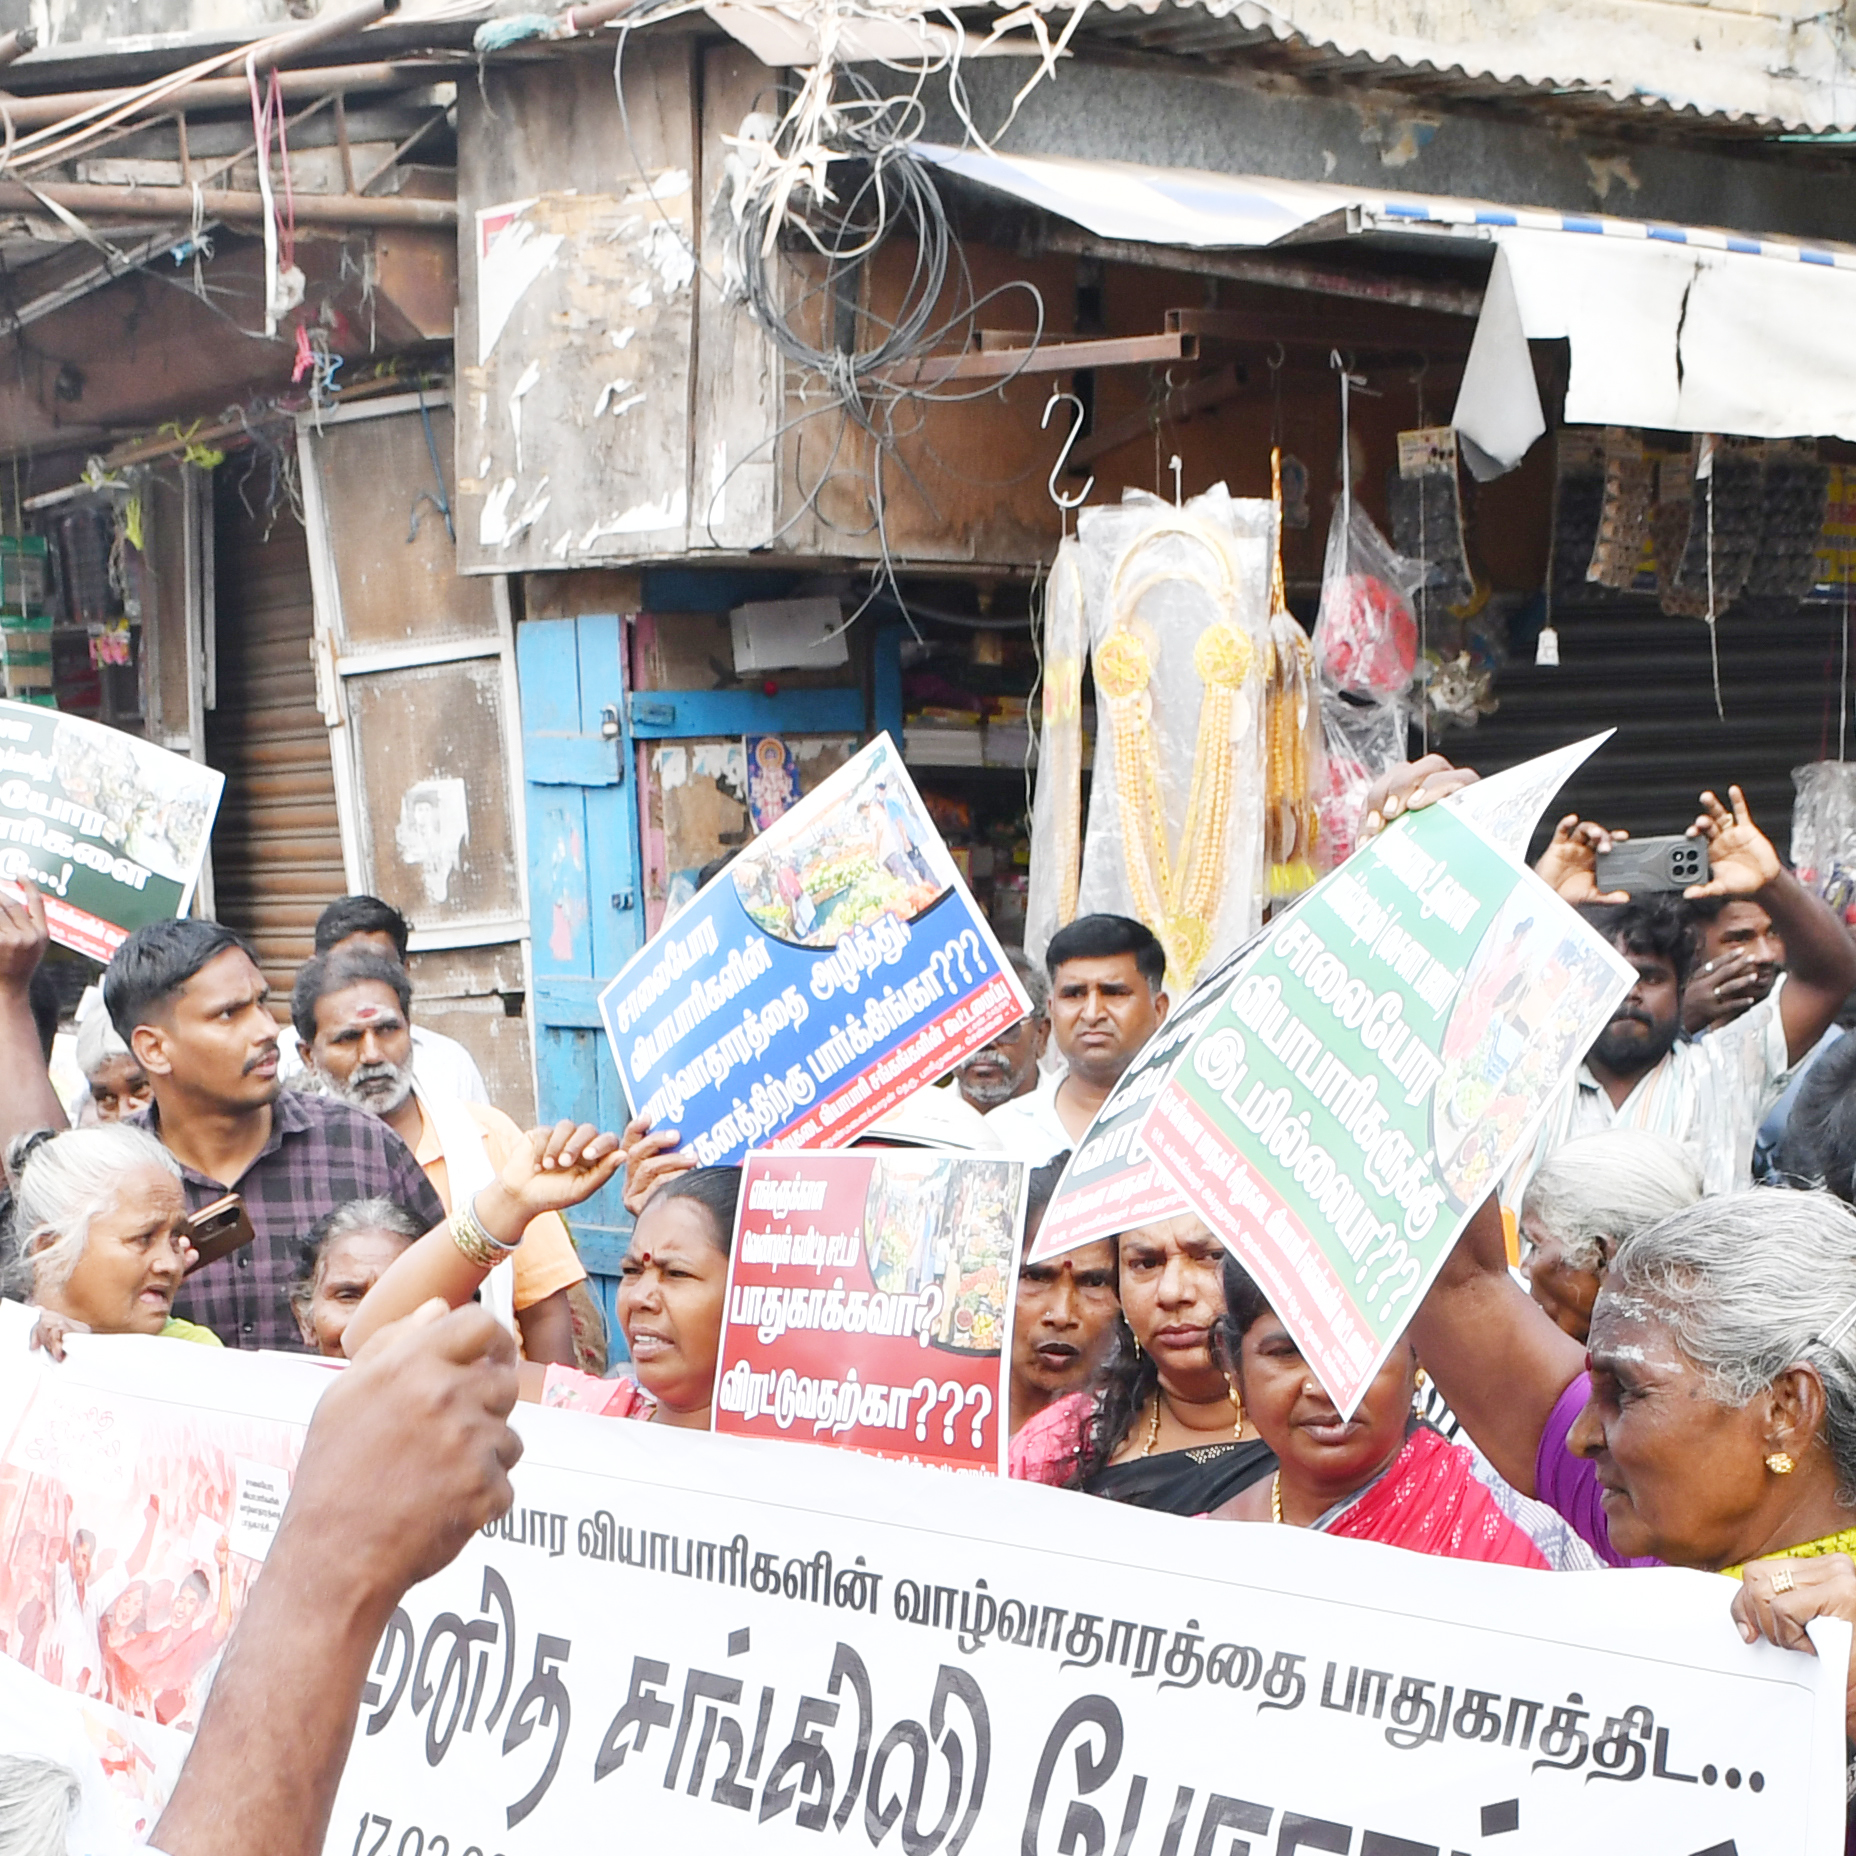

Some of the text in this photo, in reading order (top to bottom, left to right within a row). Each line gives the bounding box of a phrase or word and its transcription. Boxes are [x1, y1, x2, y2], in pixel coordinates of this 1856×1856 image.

[614, 914, 719, 1034] சாலையோர
[629, 935, 773, 1083] வியாபாரிகளின்
[679, 1060, 817, 1168] கனத்திற்கு
[812, 927, 990, 1081] பார்க்கிங்கா???
[1272, 917, 1447, 1109] சாலையோர
[1230, 973, 1446, 1243] வியாபாரிகளுக்கு
[729, 1276, 944, 1349] பாதுகாக்கவா?
[719, 1358, 993, 1449] விரட்டுவதற்கா???
[576, 1506, 884, 1612] வியாபாரிகளின்
[891, 1577, 1308, 1710] வாழ்வாதாரத்தை
[1319, 1661, 1766, 1794] பாதுகாத்திட...
